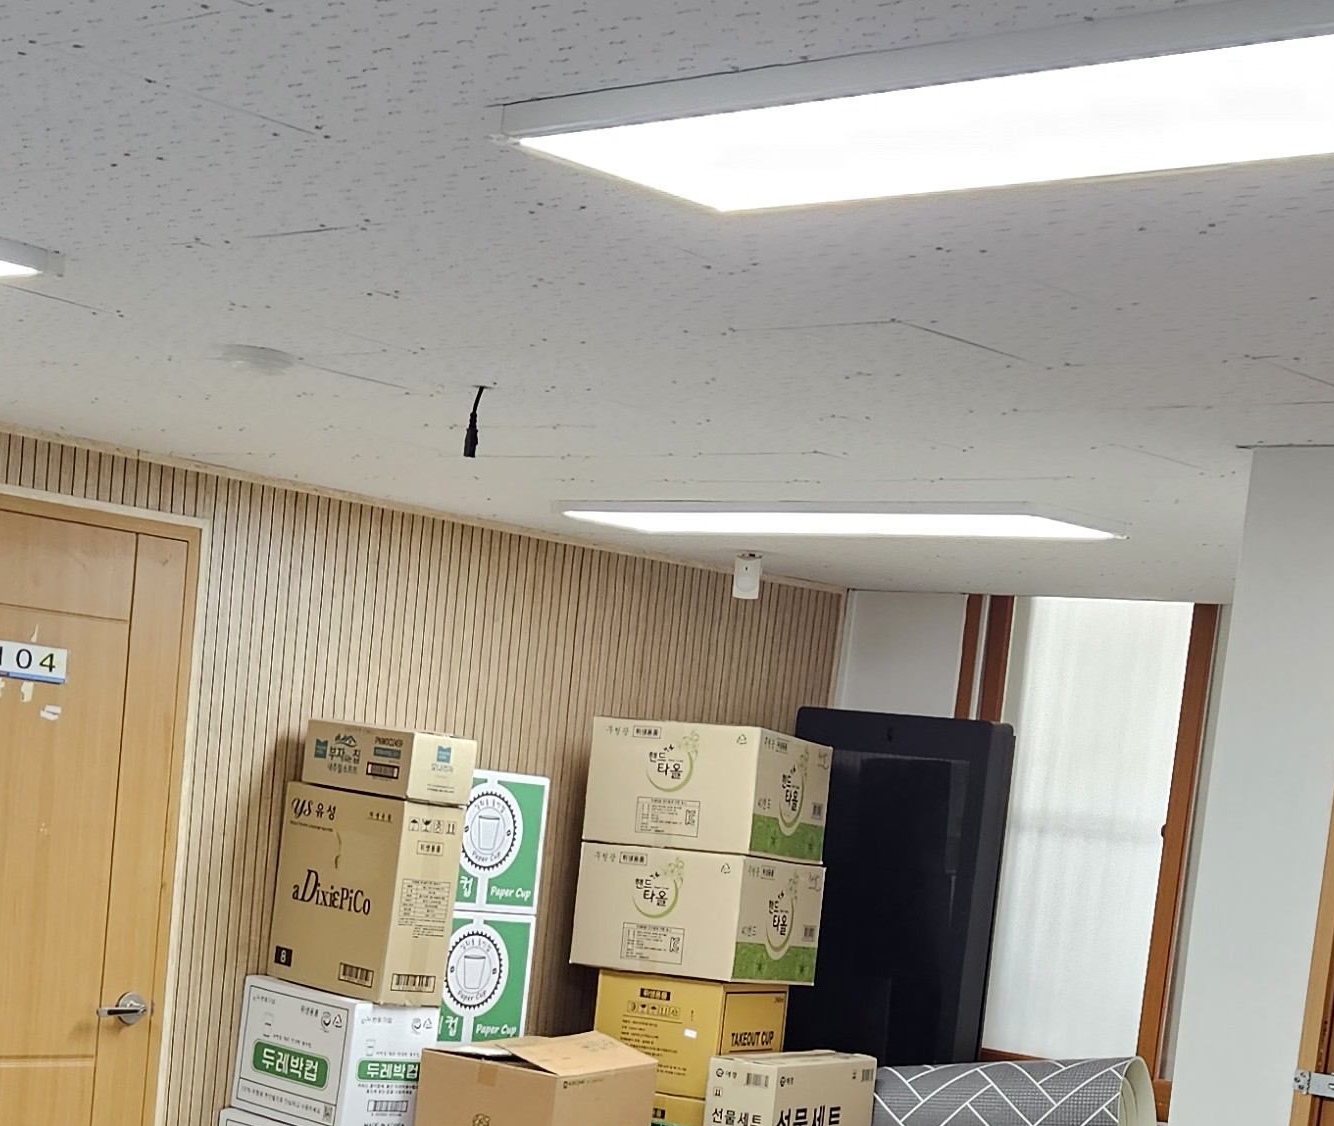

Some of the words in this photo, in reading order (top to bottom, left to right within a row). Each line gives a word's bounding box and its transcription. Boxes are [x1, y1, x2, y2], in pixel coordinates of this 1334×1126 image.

[649, 751, 667, 763] 핸드
[657, 763, 683, 780] 타올
[316, 802, 337, 821] 유성
[635, 878, 652, 889] 핸드
[490, 885, 514, 899] Paper
[515, 886, 532, 900] Cup
[642, 889, 668, 907] 타올
[280, 950, 287, 963] 8
[475, 1018, 499, 1035] Paper
[501, 1020, 517, 1036] Cup
[731, 1031, 761, 1048] TAKEOUT
[761, 1030, 774, 1046] CUP
[261, 1047, 319, 1082] 두레박컵
[367, 1062, 419, 1079] 두레박컵
